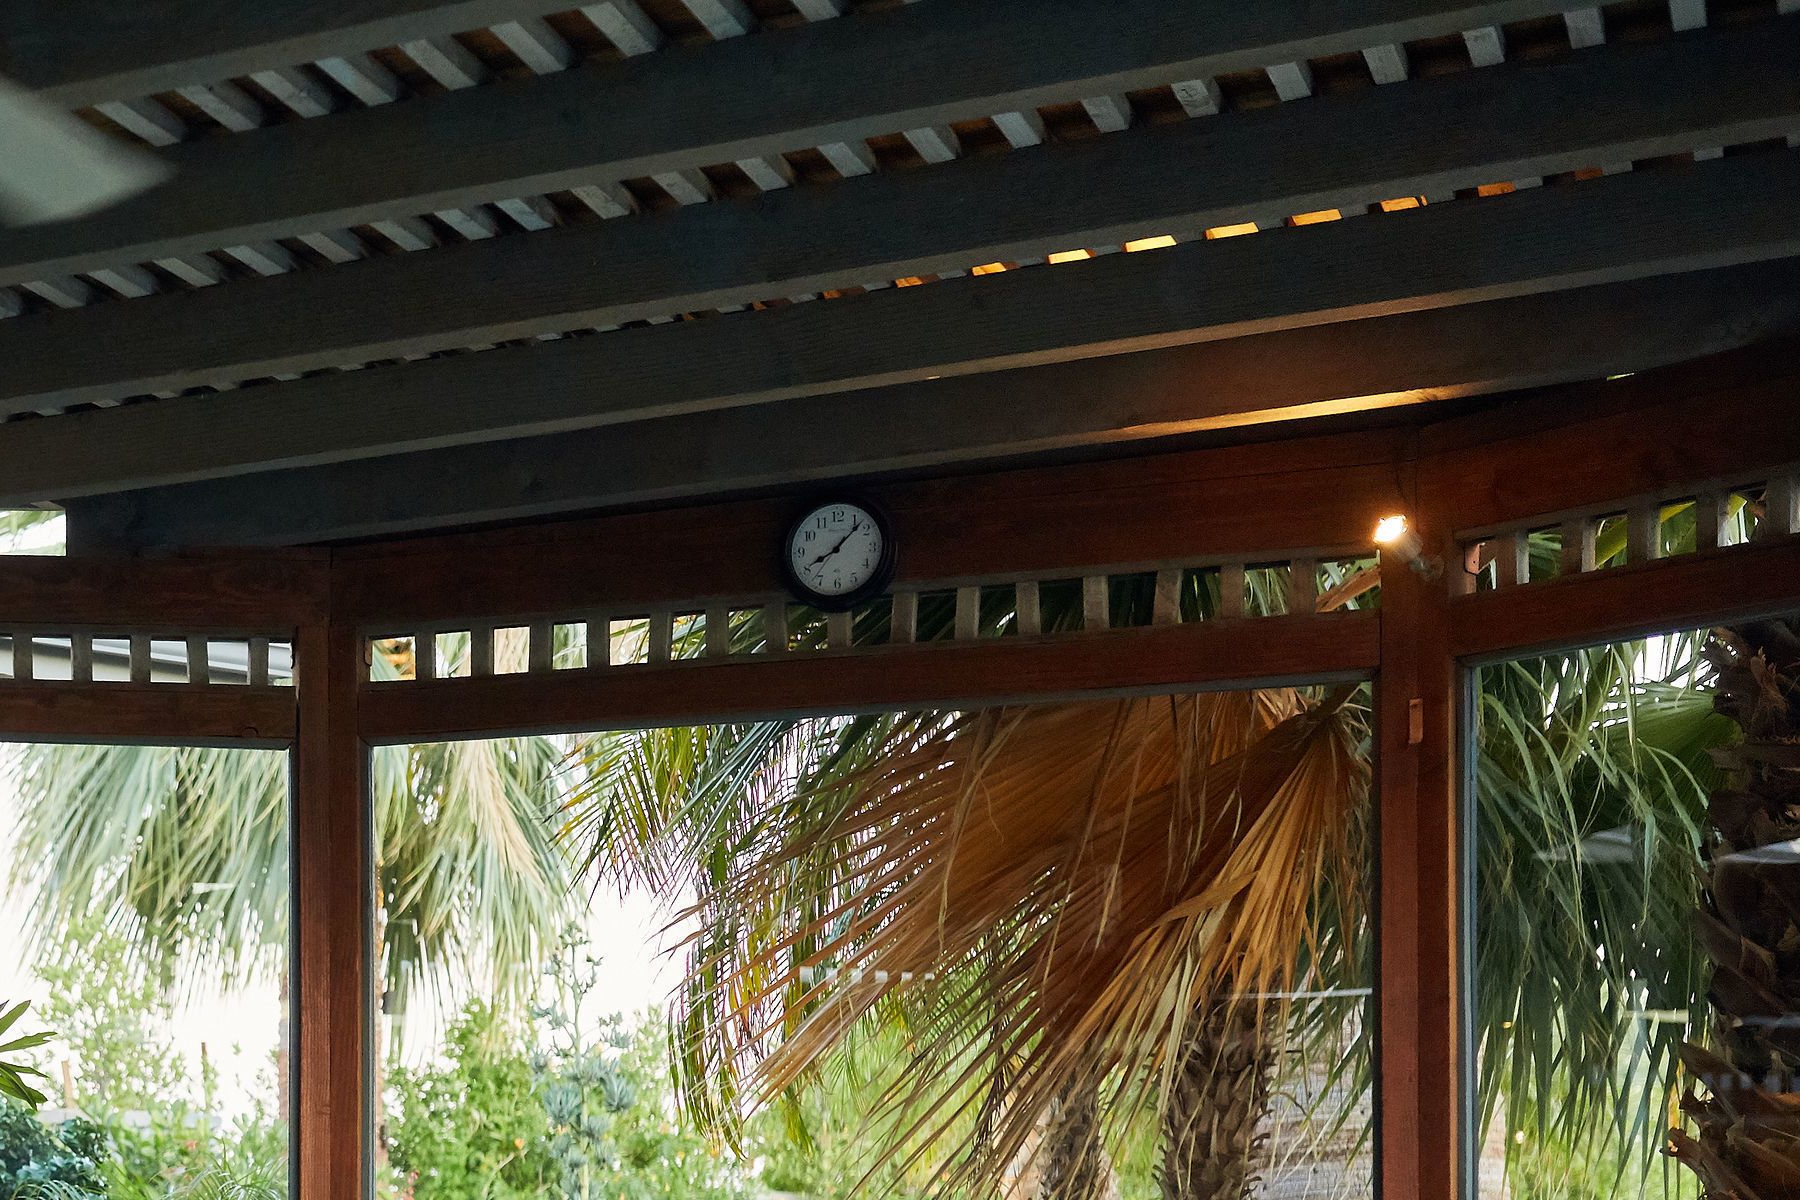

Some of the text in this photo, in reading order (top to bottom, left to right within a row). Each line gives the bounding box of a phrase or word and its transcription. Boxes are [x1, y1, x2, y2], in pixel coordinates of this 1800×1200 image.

[832, 511, 844, 522] 12
[817, 517, 826, 528] 11
[863, 524, 870, 535] 2
[805, 530, 816, 541] 10
[798, 547, 805, 558] 9
[869, 542, 876, 552] 3
[862, 558, 869, 568] 4
[817, 574, 823, 586] 7
[850, 572, 857, 583] 5
[834, 578, 841, 589] 6
